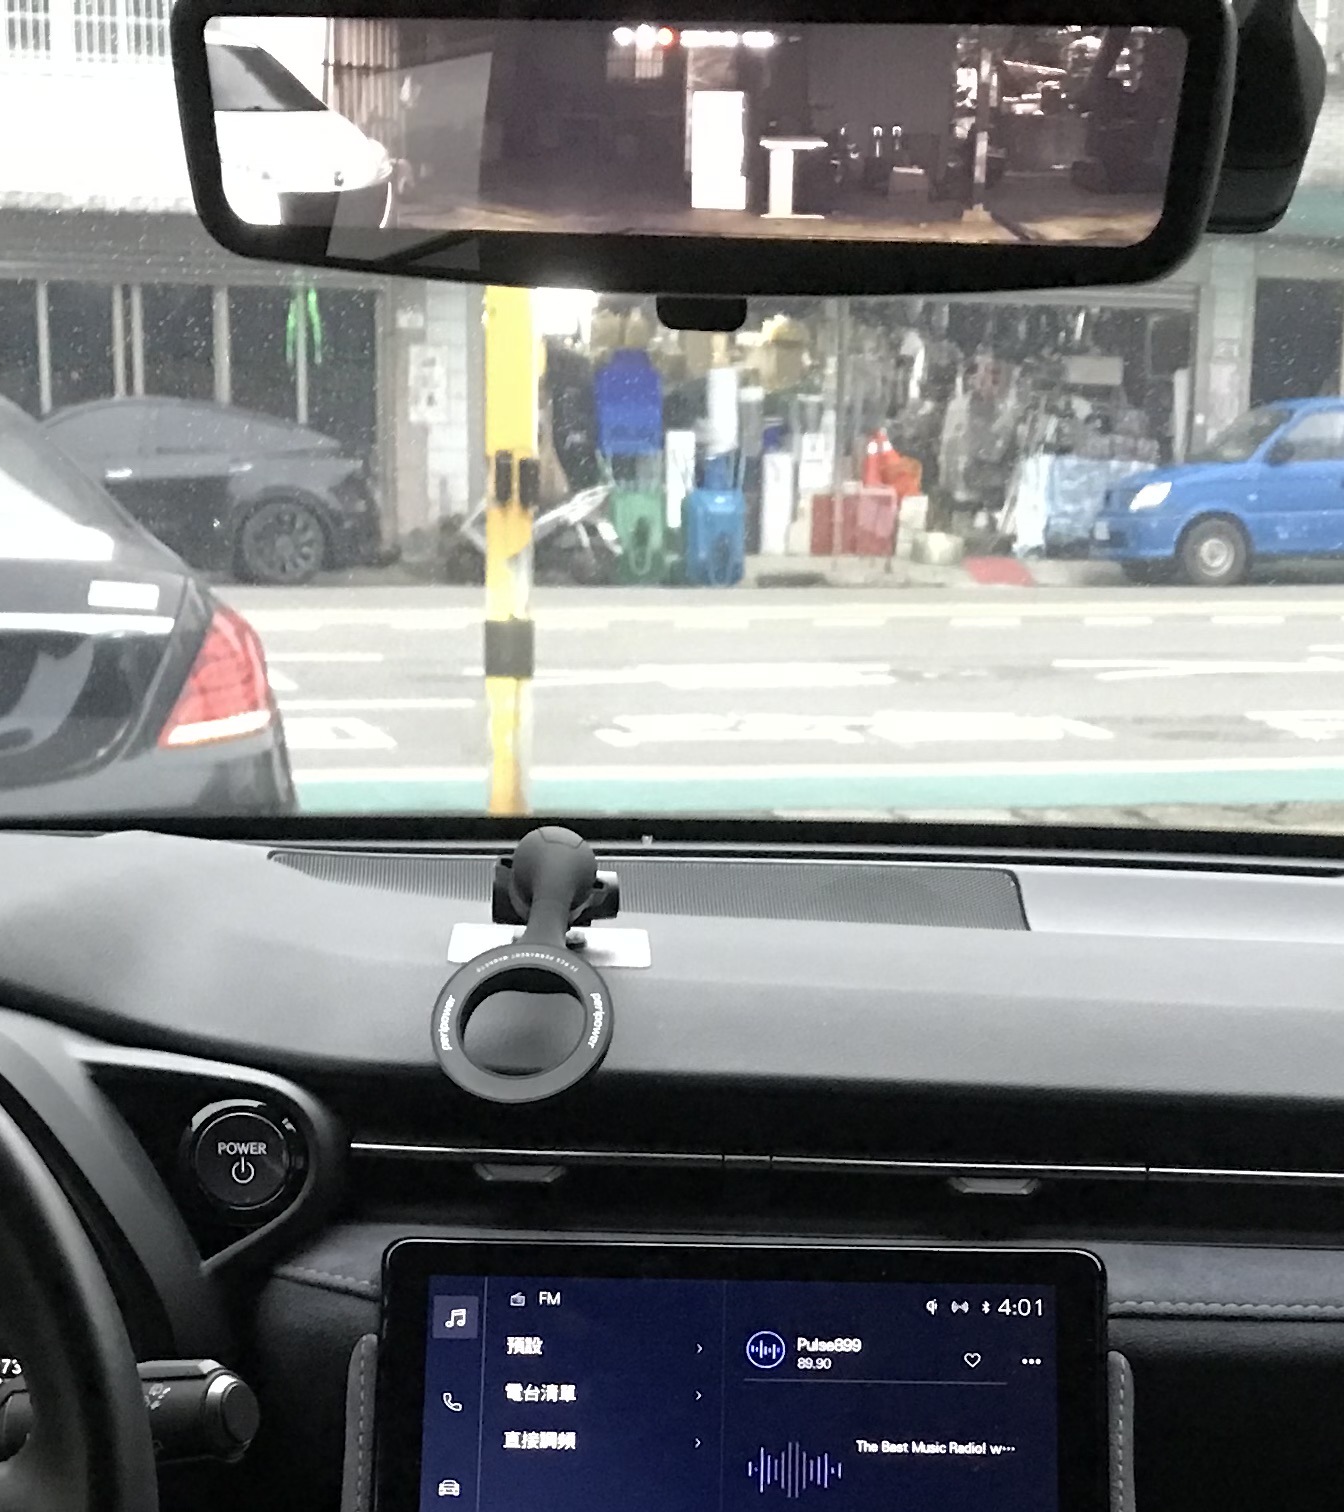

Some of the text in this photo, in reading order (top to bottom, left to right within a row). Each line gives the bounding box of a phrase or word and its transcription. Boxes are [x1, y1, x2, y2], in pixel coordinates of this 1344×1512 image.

[438, 995, 456, 1051] peripower
[587, 992, 605, 1049] peripower
[217, 1141, 268, 1157] POWER
[538, 1291, 562, 1306] FM
[997, 1298, 1044, 1317] 4:01
[796, 1337, 863, 1354] Pulse899
[797, 1357, 832, 1370] 89.90
[504, 1383, 577, 1403] 電台清單
[856, 1440, 878, 1453] The
[881, 1441, 909, 1454] Best
[912, 1441, 947, 1454] Music
